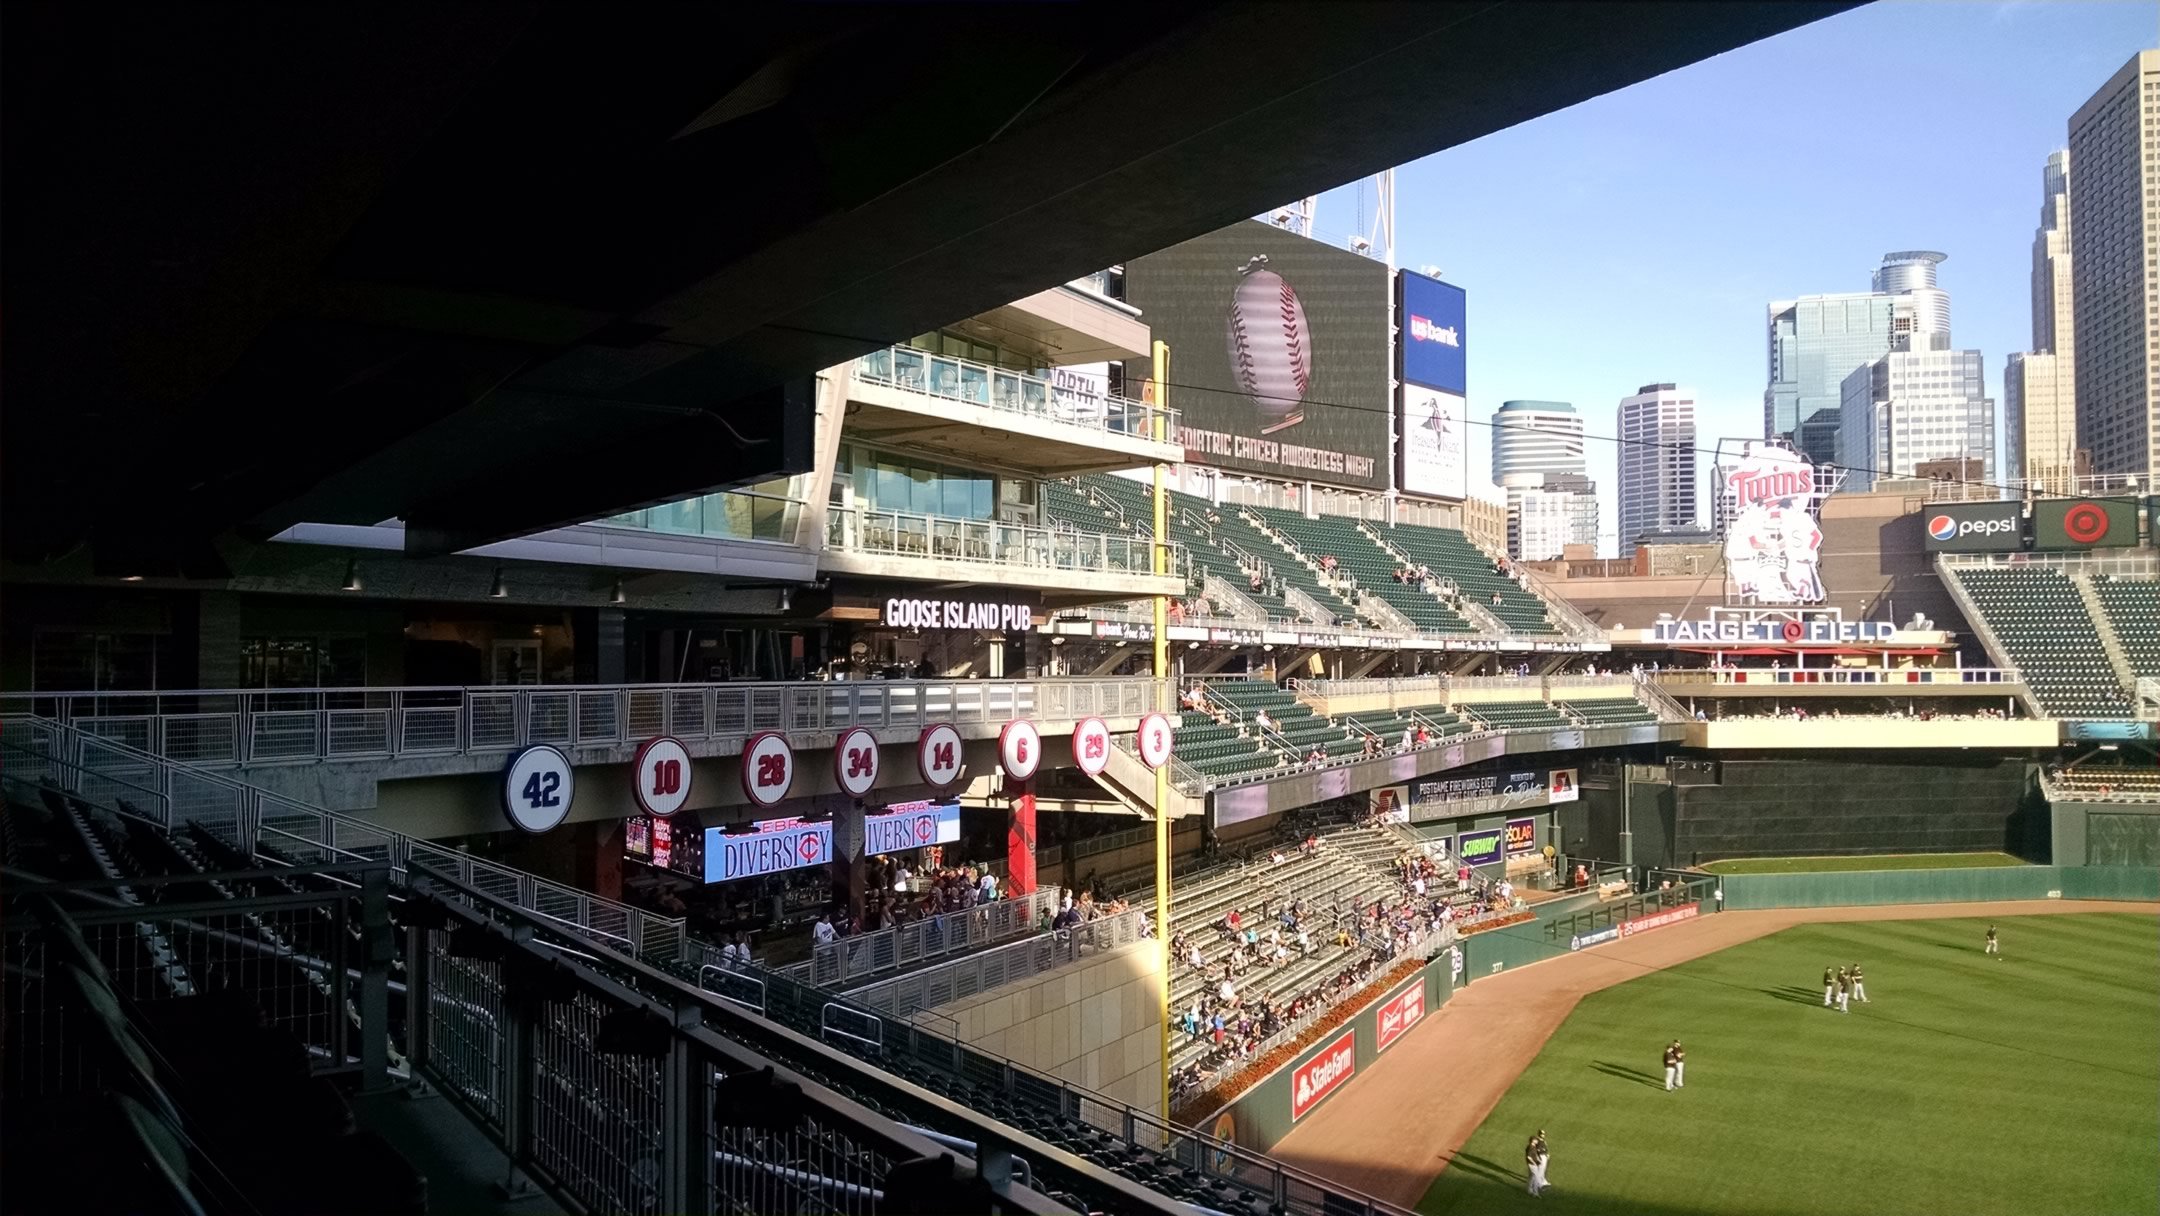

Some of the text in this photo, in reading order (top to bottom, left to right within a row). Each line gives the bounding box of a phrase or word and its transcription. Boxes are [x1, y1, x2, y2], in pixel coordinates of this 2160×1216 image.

[1234, 435, 1278, 464] CANCER
[1281, 443, 1343, 473] AWARENESS
[1345, 454, 1374, 478] NIGHT
[1728, 465, 1812, 508] Twins
[1959, 516, 2017, 537] pepsi
[887, 598, 1032, 631] GOOSE ISLAND PUB
[1656, 621, 1898, 641] TARGET FIELD
[932, 741, 954, 771] 14
[1017, 737, 1027, 763] 6
[1085, 734, 1104, 758] 29
[1154, 729, 1163, 752] 3
[653, 759, 681, 796] 10
[757, 753, 786, 787] 28
[848, 747, 873, 778] 34
[522, 771, 560, 809] 42
[867, 814, 941, 854] IVERSITY
[1461, 835, 1500, 858] SUBWAY
[725, 830, 829, 879] DIVERSITY
[1492, 962, 1504, 973] 377
